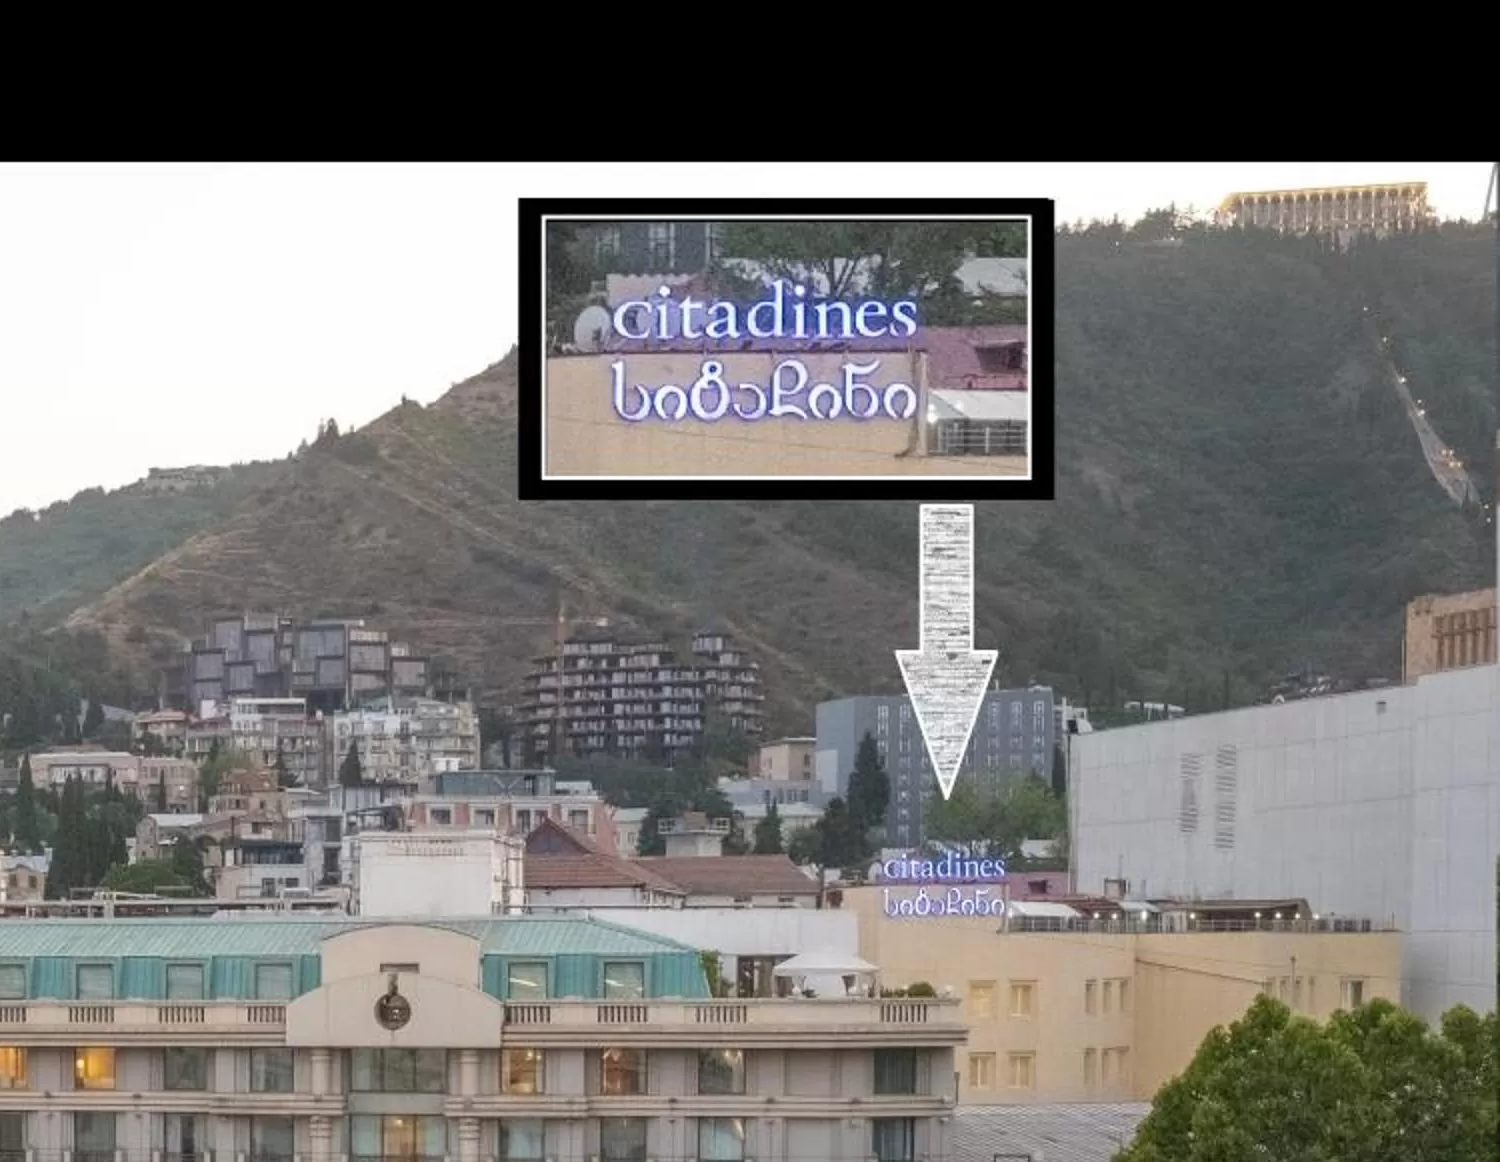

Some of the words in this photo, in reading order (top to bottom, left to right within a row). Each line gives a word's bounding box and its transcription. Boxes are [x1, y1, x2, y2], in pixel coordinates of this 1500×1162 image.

[612, 278, 918, 341] citadines
[611, 358, 918, 422] სიტადინი
[883, 850, 1005, 879] citadines
